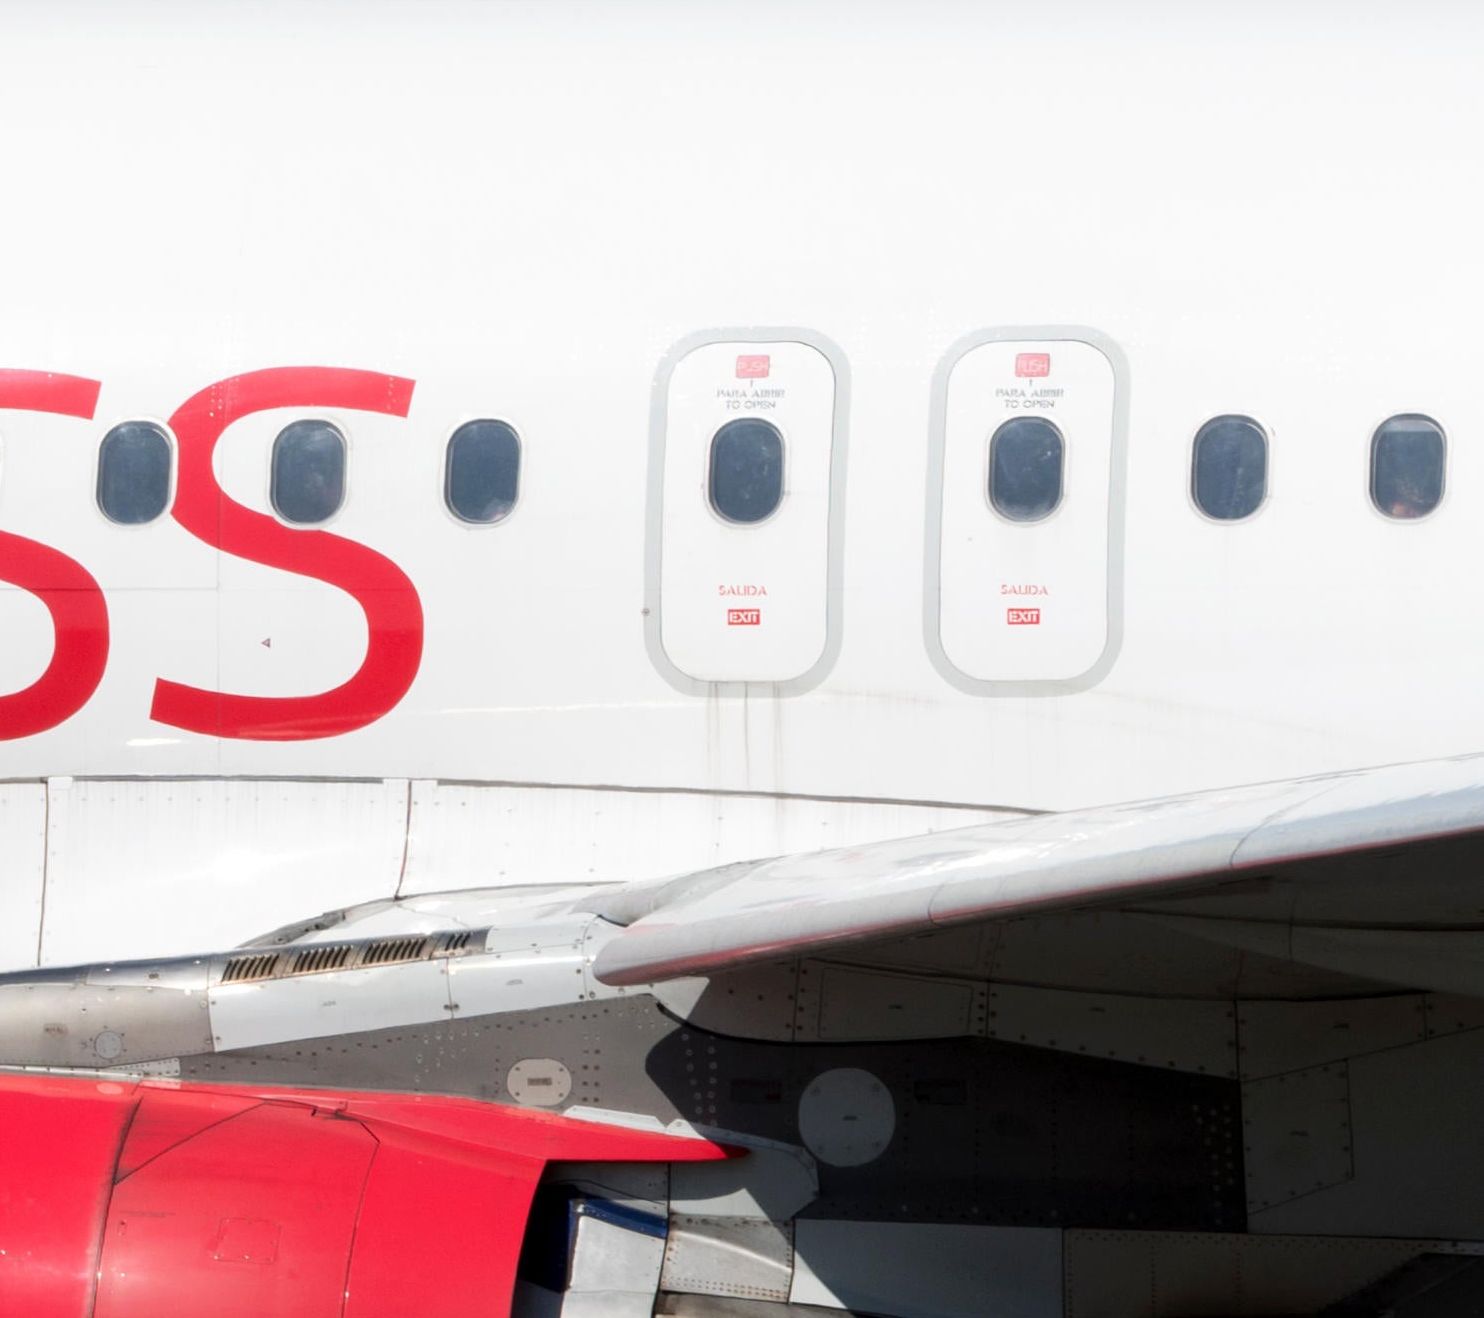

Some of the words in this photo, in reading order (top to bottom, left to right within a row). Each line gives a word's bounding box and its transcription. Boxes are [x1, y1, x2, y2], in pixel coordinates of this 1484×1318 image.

[718, 585, 767, 596] SALIDA
[1000, 584, 1048, 595] SALIDA
[729, 611, 759, 623] EXIT
[1009, 610, 1039, 623] EXIT
